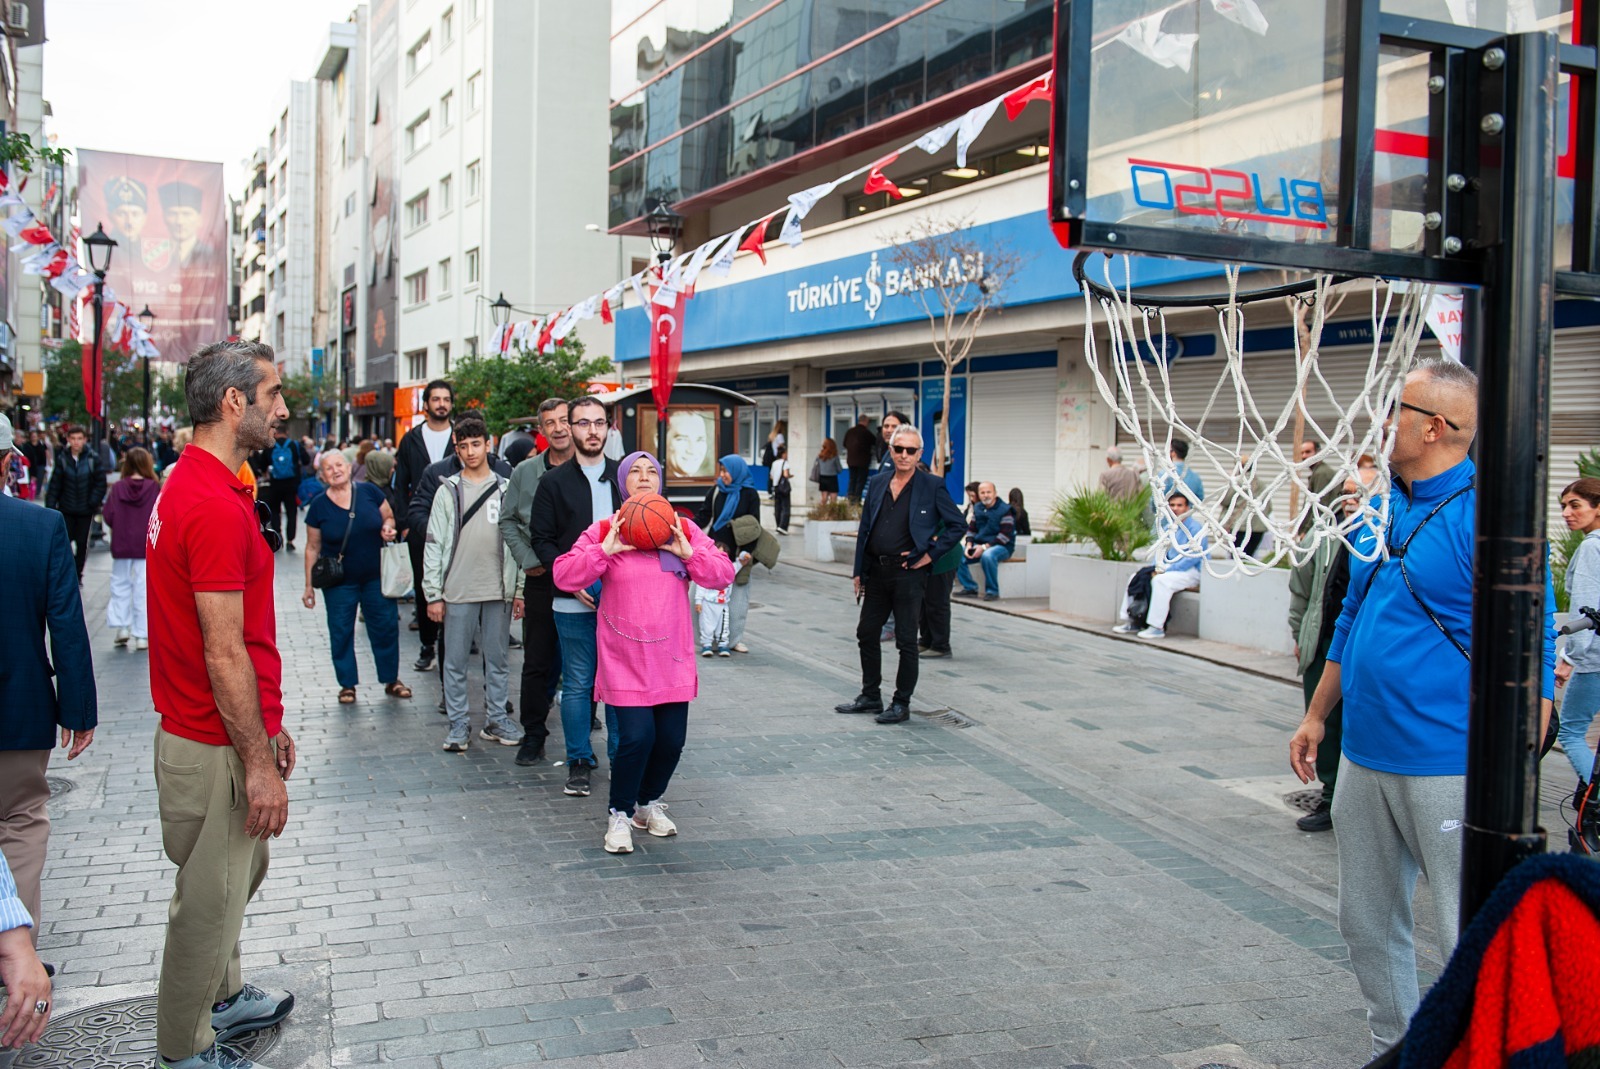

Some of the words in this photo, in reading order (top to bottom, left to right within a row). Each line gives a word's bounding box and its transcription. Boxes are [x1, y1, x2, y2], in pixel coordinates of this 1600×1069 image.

[132, 280, 158, 294] 1912
[787, 275, 863, 313] TÜRKİYE
[885, 252, 985, 297] BANKASI
[1443, 819, 1460, 828] NIKE
